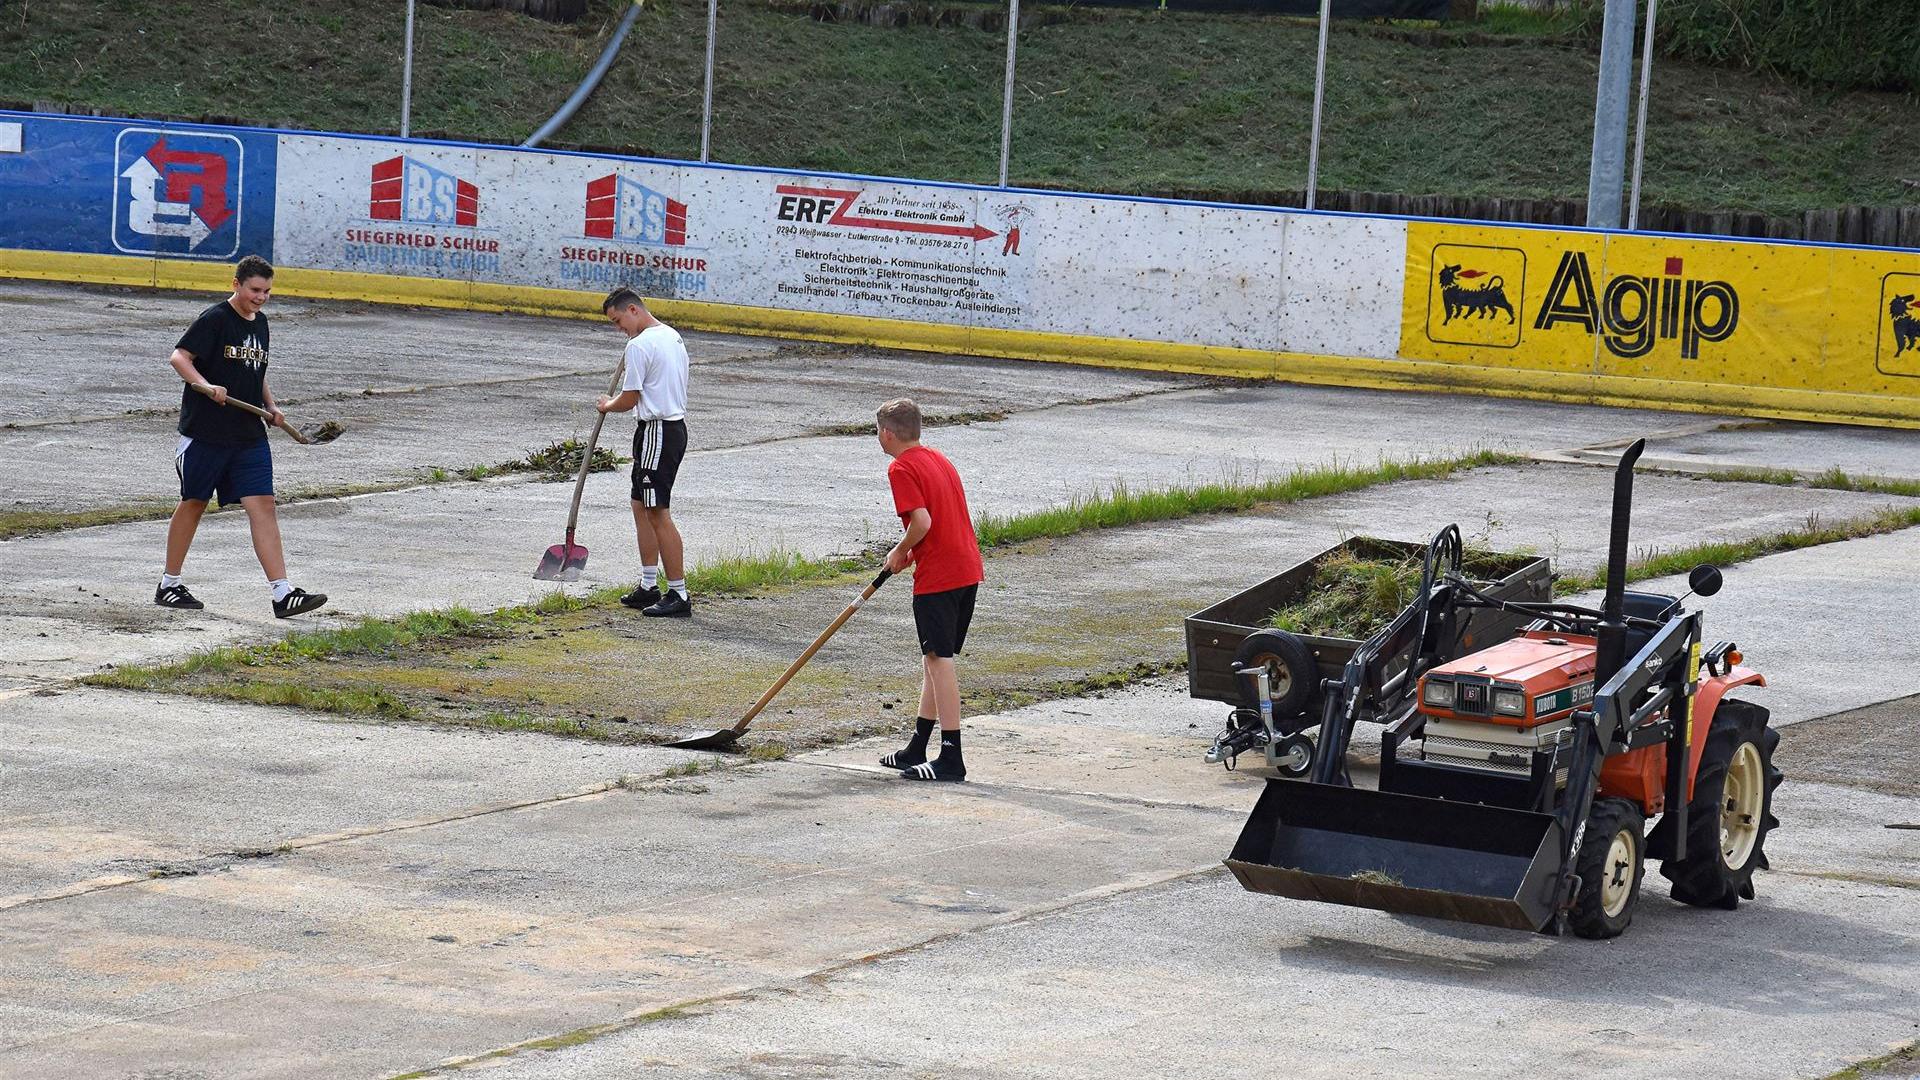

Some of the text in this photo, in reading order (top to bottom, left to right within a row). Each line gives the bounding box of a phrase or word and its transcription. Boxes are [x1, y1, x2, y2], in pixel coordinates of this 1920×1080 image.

[408, 163, 454, 222] BS
[877, 195, 889, 205] Ihr
[891, 197, 920, 208] Partner
[922, 201, 936, 210] seit
[621, 180, 663, 241] BS
[858, 206, 888, 216] Elektro
[894, 209, 938, 221] Elektronik
[940, 213, 965, 223] GmbH
[346, 229, 499, 253] SIEGFRIED SCHUR
[776, 226, 798, 236] 02943
[799, 228, 842, 239] Weißwasser
[848, 232, 894, 244] Lutherstraße
[905, 237, 918, 246] Tel.
[450, 252, 499, 272] GMBH
[561, 247, 707, 271] SIEGFRIED SCHUR
[795, 249, 882, 265] Elektrofachbetrieb
[891, 258, 1006, 277] Kommunikationstechnik
[804, 274, 892, 290] Sicherheitstechnik
[820, 263, 868, 276] Elektronik
[876, 269, 979, 287] Elektromaschinenbau
[778, 284, 838, 298] Einzelhandel
[847, 290, 882, 302] Tiefbau
[891, 294, 947, 308] Trockenbau
[955, 301, 1021, 316] Ausleihdienst
[1533, 250, 1740, 360] Agip
